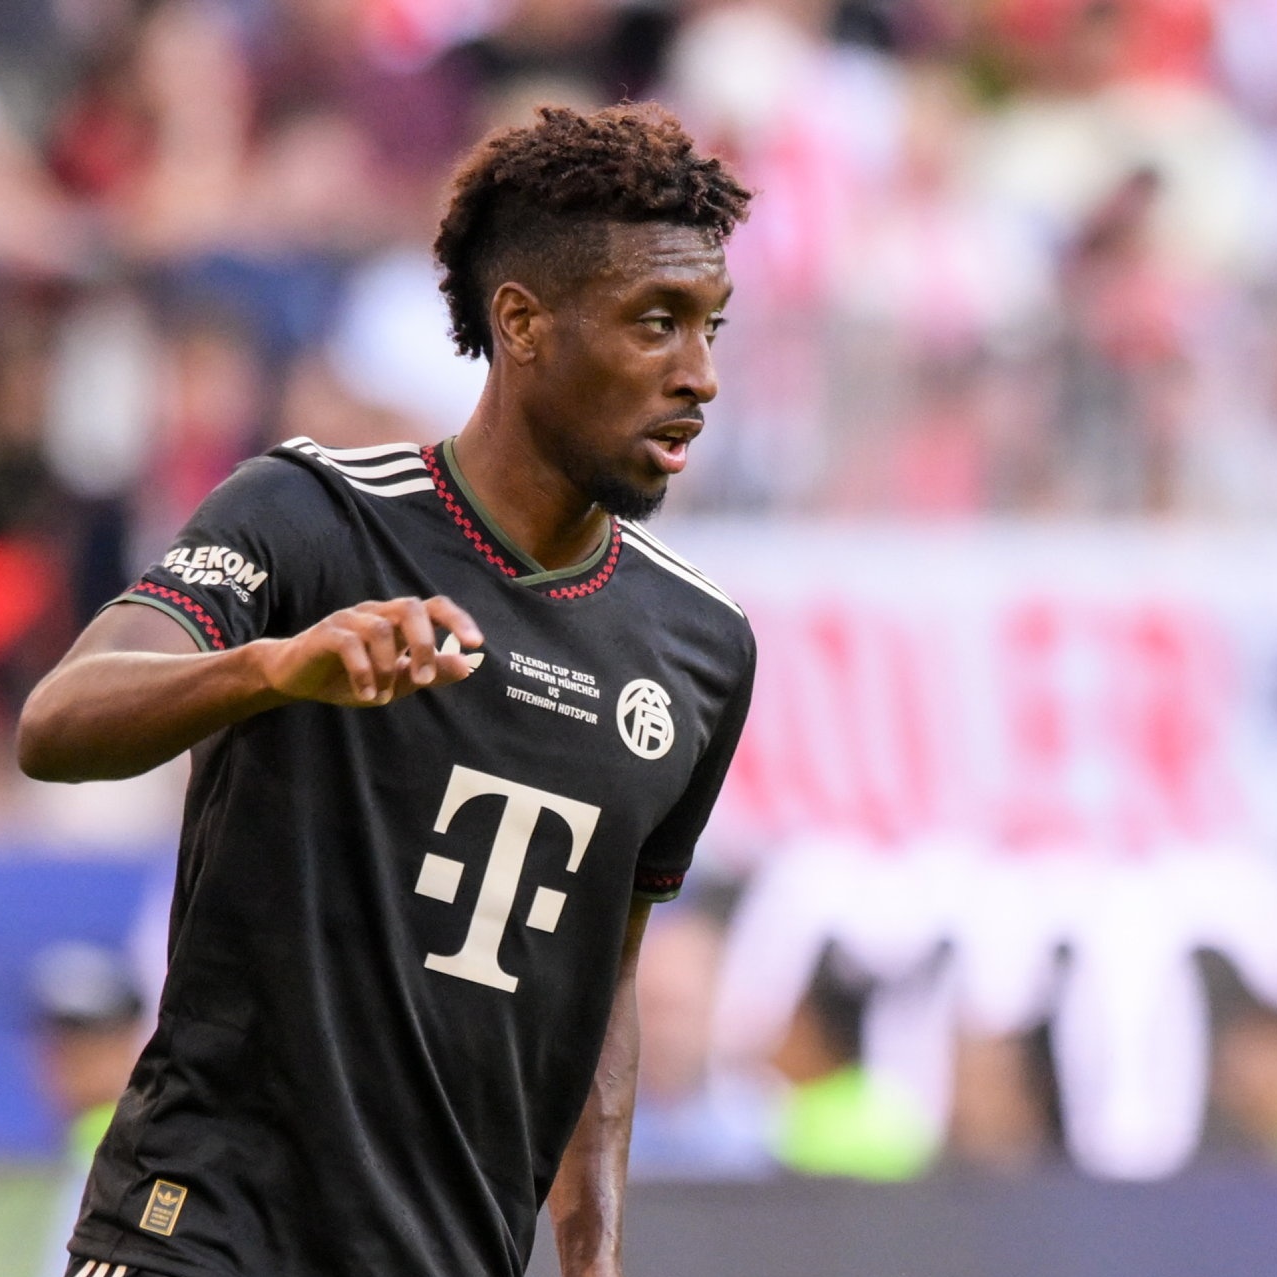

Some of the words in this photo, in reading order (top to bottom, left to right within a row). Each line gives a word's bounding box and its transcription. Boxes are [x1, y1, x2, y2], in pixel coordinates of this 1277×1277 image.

[162, 545, 268, 592] ELEKOM
[509, 661, 522, 673] FC
[523, 665, 556, 684] BAYERN
[510, 651, 551, 672] TELEKOM
[552, 664, 570, 677] CUP
[571, 670, 596, 685] 2025
[506, 685, 557, 711] TOTTENHAM
[557, 703, 598, 725] HOTSPUR
[414, 764, 602, 994] T
